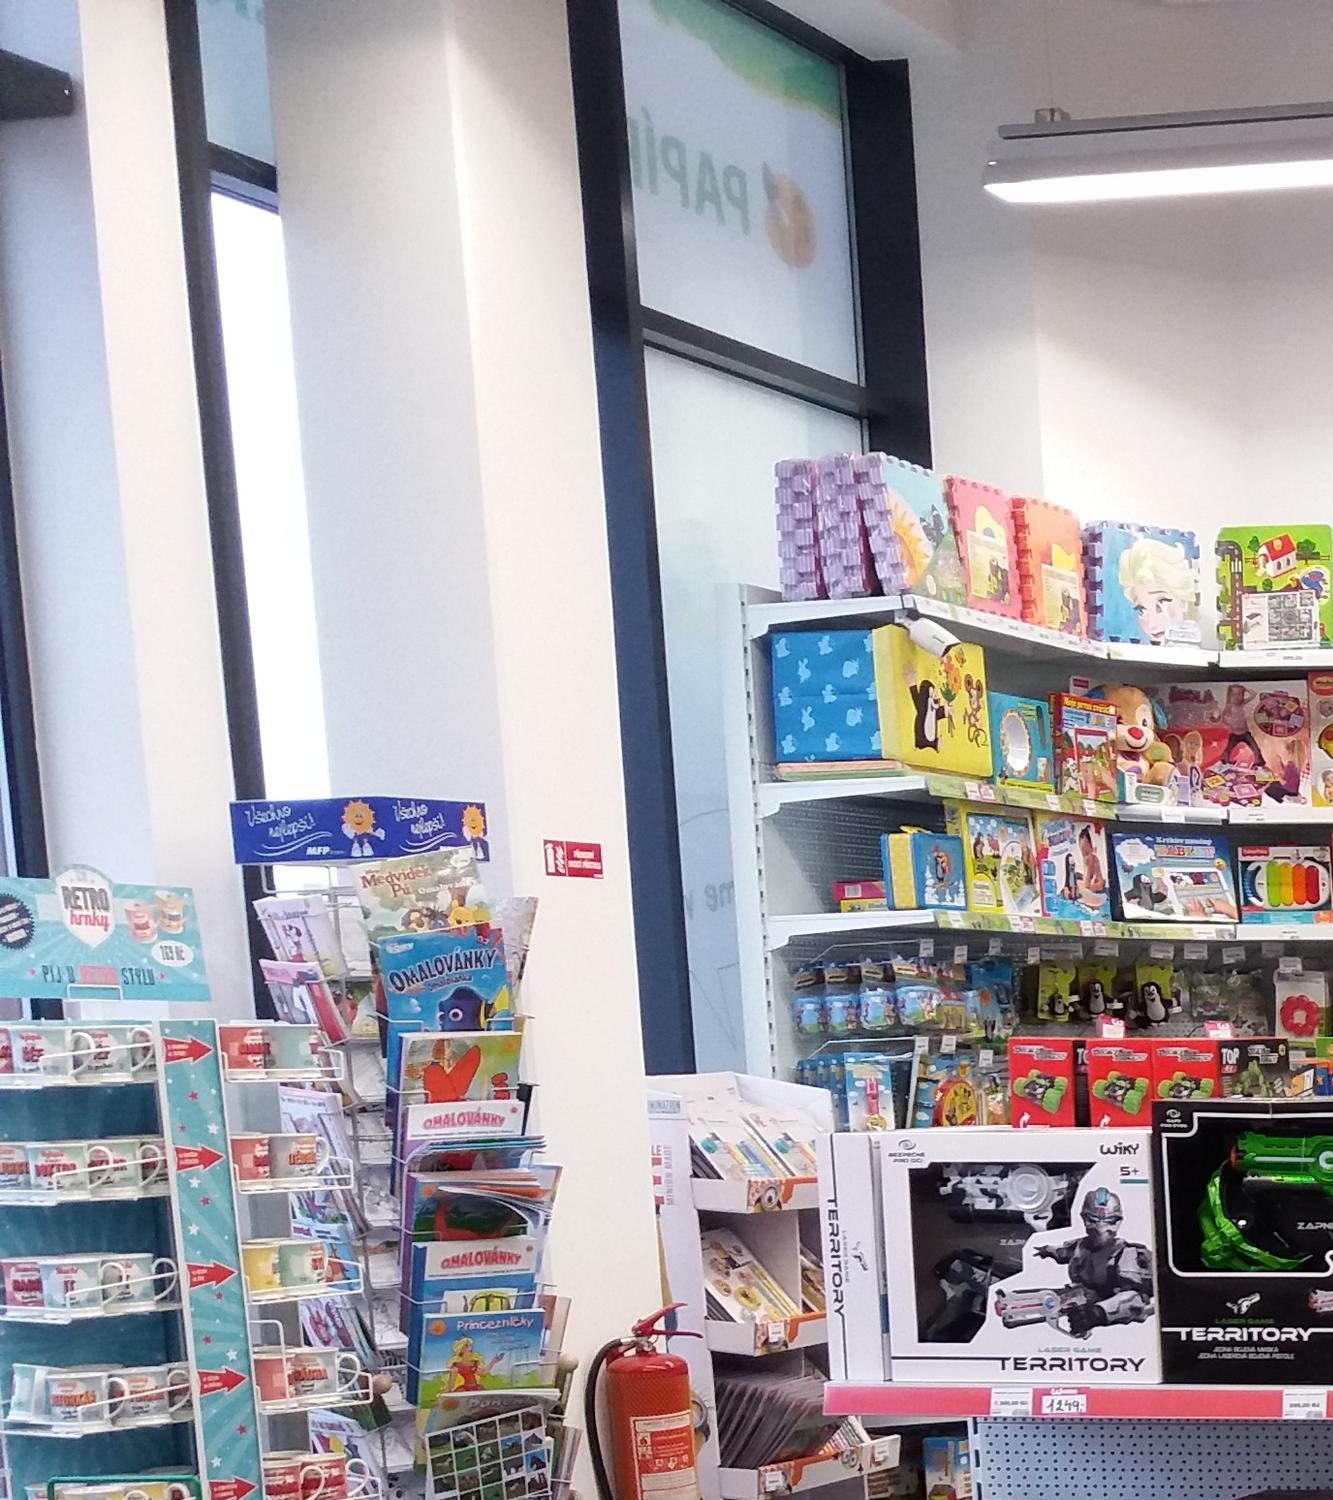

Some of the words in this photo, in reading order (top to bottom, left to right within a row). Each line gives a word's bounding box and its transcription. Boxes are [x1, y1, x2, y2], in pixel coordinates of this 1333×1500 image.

[306, 846, 331, 856] MFP
[61, 885, 110, 913] RETRO
[69, 911, 110, 933] hrnky
[388, 949, 499, 993] OMALOVÁNKY
[1221, 1048, 1239, 1065] TOP
[1120, 1165, 1140, 1177] 5+
[827, 1198, 846, 1318] TERRITORY
[1177, 1327, 1313, 1342] TERRITORY
[999, 1357, 1147, 1373] TERRITORY
